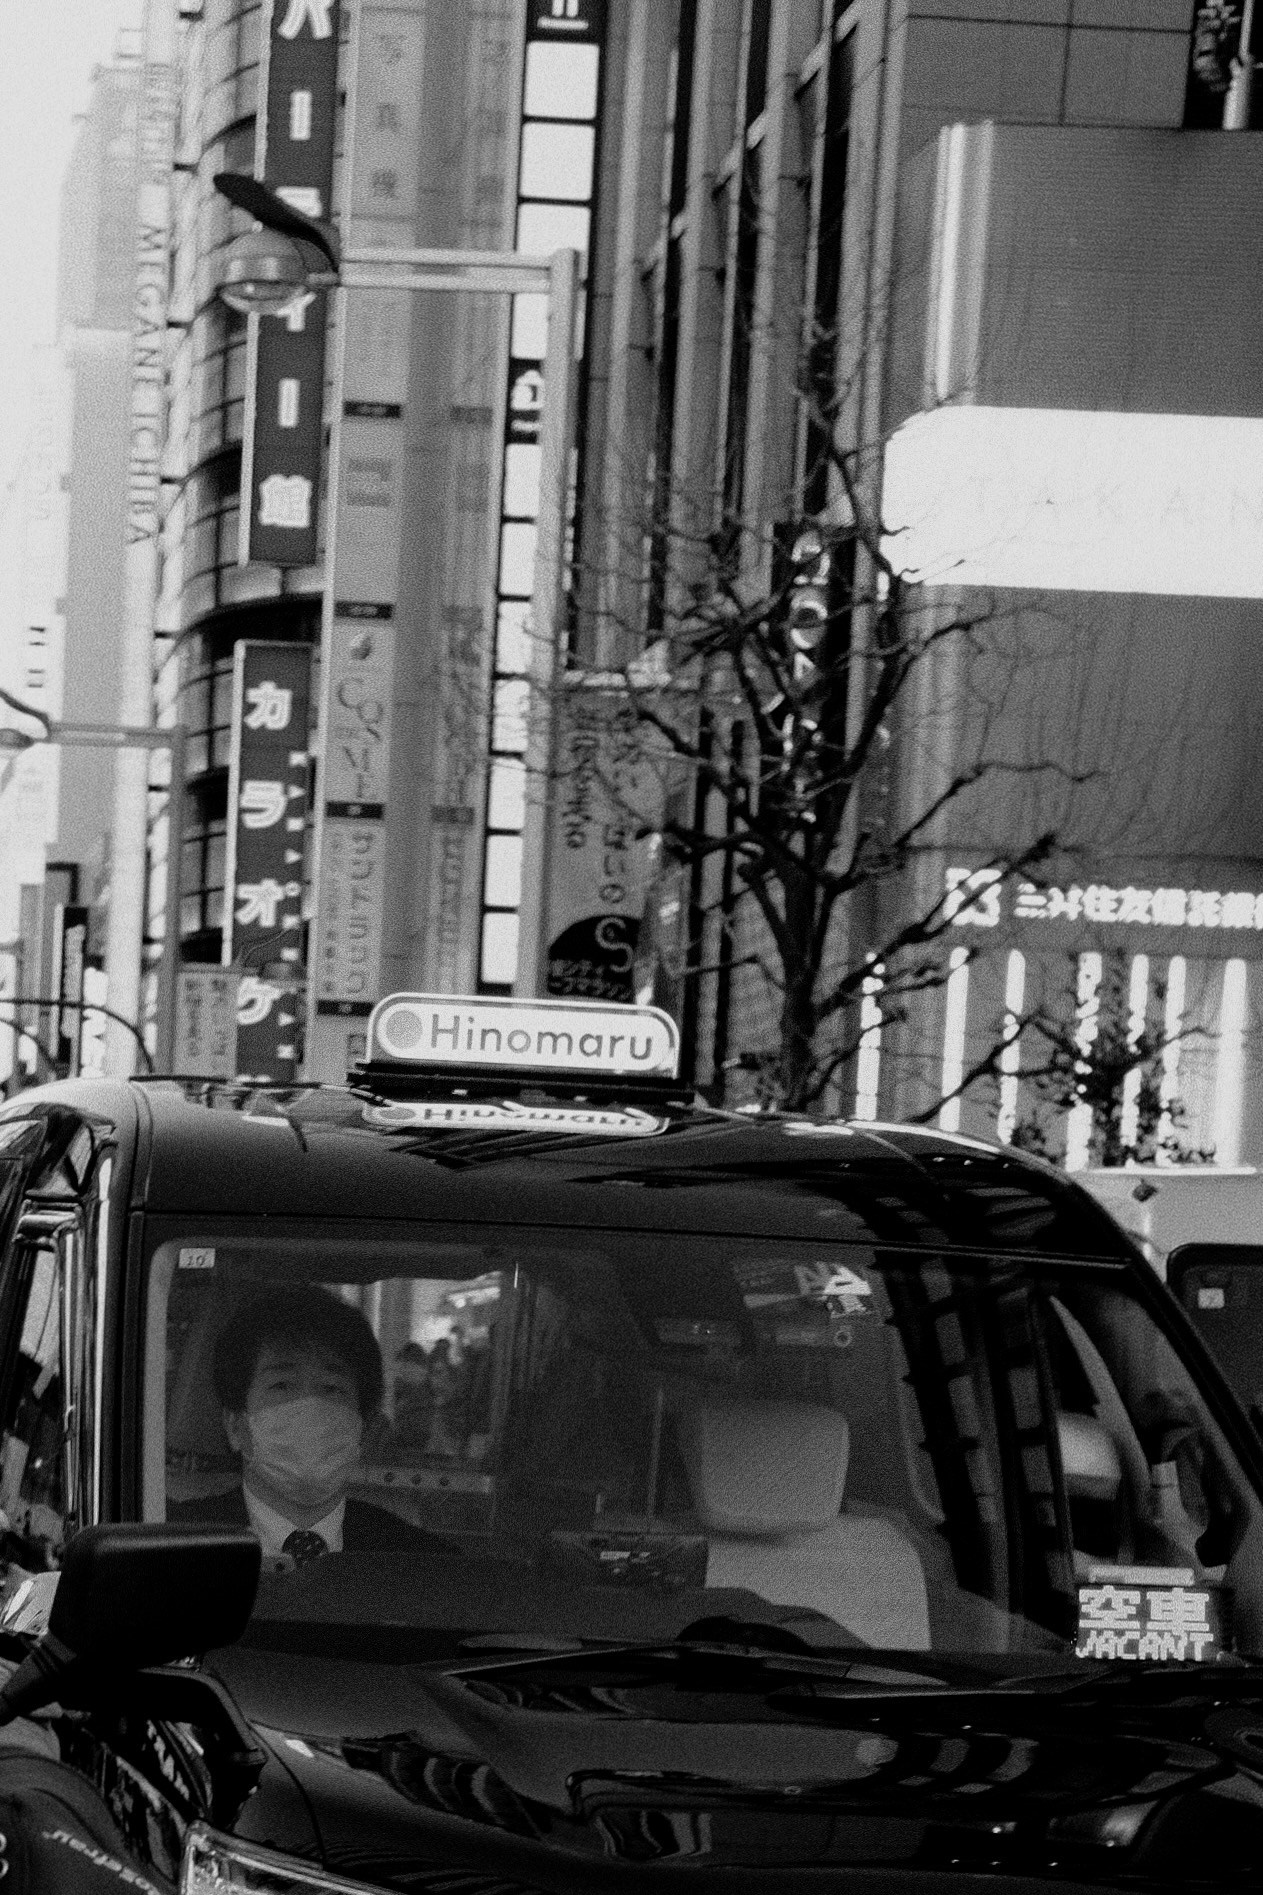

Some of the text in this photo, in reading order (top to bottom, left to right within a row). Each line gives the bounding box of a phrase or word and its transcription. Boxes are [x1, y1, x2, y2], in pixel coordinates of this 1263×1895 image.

[234, 679, 294, 1084] カラオケ
[430, 1013, 653, 1061] Hinomaru
[1078, 1584, 1210, 1636] 空車
